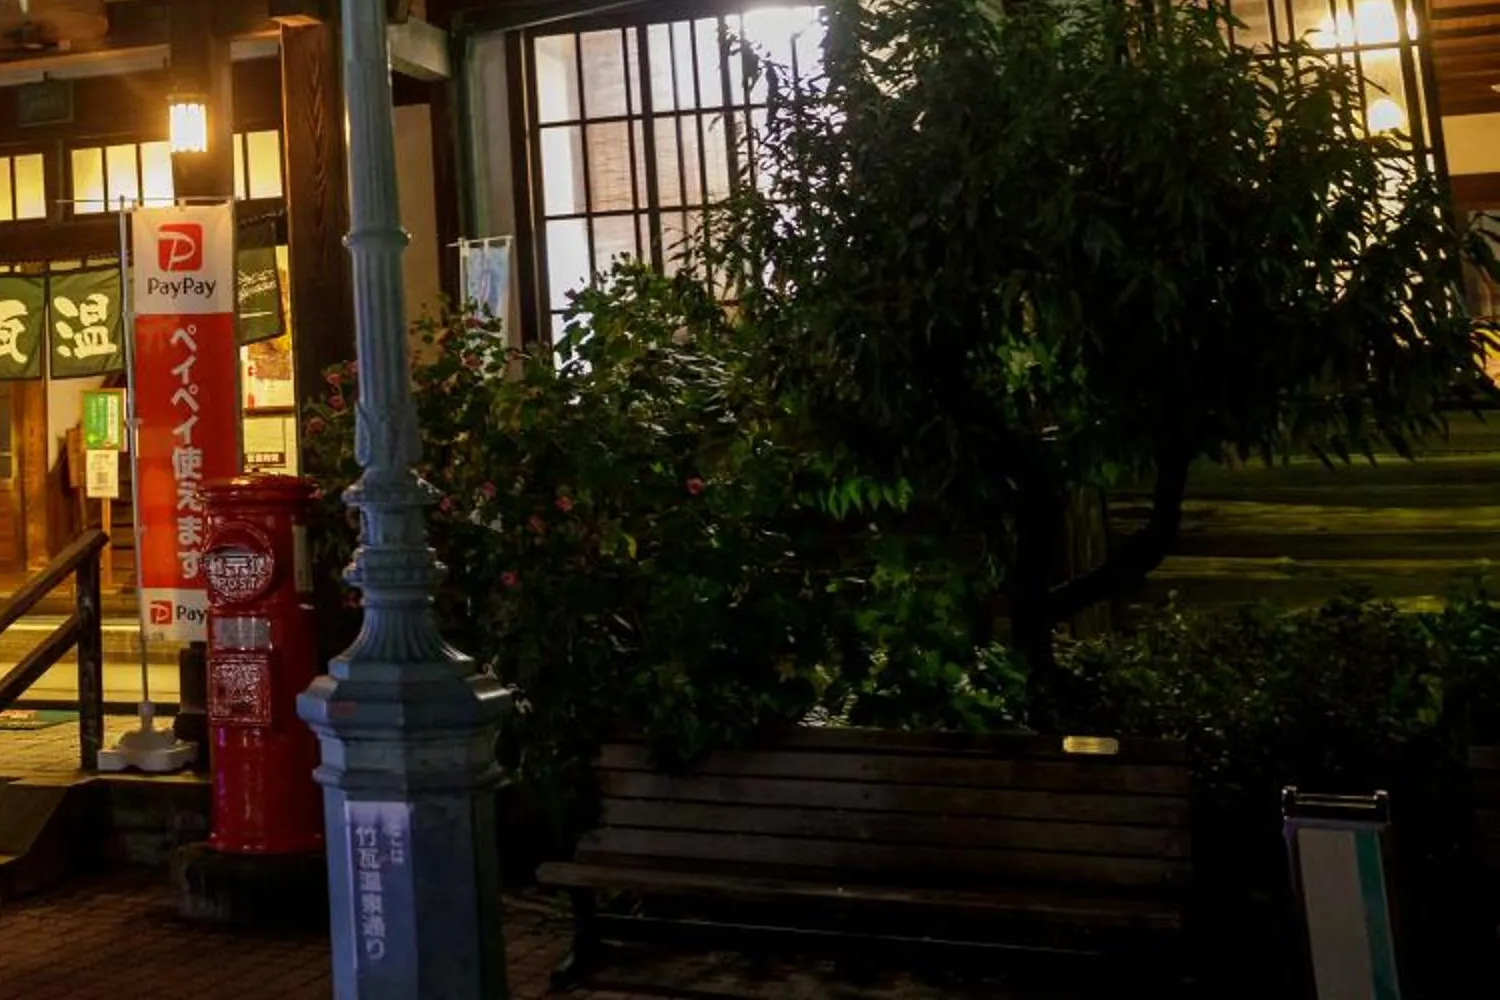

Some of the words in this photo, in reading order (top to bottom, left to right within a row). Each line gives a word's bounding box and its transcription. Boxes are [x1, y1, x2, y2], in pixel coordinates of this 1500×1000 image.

[147, 277, 217, 300] PayPay
[169, 324, 204, 580] ペイペイ使えます
